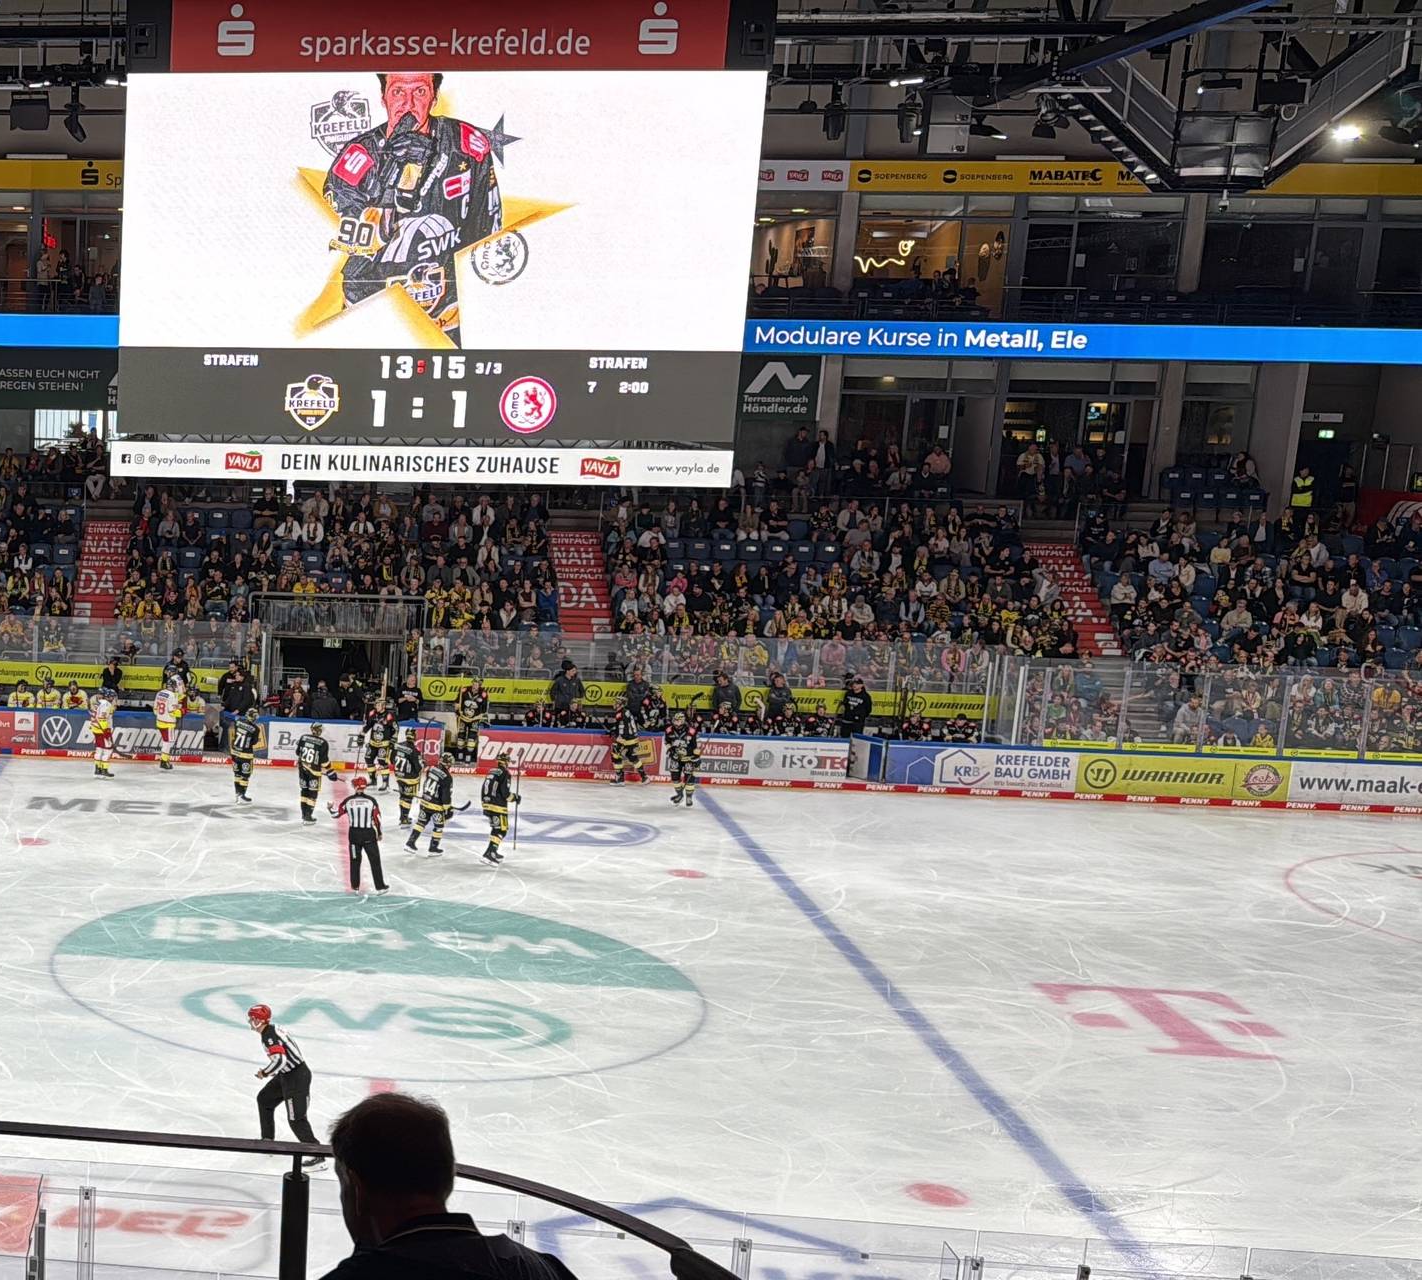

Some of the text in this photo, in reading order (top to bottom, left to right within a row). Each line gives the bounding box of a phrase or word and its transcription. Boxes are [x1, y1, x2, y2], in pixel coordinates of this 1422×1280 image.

[299, 27, 591, 58] sparkasse-krefeld.de
[314, 120, 369, 135] KREFELD
[874, 173, 928, 181] SOEPENBERG
[960, 173, 1014, 181] SOEPENBERG
[1029, 168, 1103, 182] MABATEC
[338, 219, 374, 247] 90
[417, 228, 462, 261] SWK
[754, 326, 1088, 352] Modulare Kurse in Metall, Ele
[203, 354, 259, 367] STRAFEN
[589, 357, 648, 370] STRAFEN
[380, 355, 503, 380] 13:15 3/3
[35, 369, 65, 379] EUCH
[67, 369, 101, 380] NICHT
[0, 381, 35, 391] REGEN
[38, 381, 84, 392] STEHEN!
[587, 381, 648, 394] 7 2:00
[289, 399, 336, 409] KREFELD
[510, 391, 520, 419] DEG
[743, 394, 809, 404] Terrassendach
[371, 390, 386, 427] 1
[452, 390, 468, 428] 1
[742, 403, 808, 415] Händler.de
[148, 454, 211, 467] @yaylaonline
[228, 453, 261, 471] YAYLA
[281, 453, 560, 474] DEIN KULINARISCHES ZUHAUSE
[582, 459, 619, 476] YAYLA
[646, 463, 720, 476] www.yayla.de
[88, 523, 131, 534] EINFACH
[551, 533, 597, 544] EINFACH
[83, 556, 126, 567] EINFACH
[555, 568, 603, 579] EINFACH
[78, 569, 121, 594] DA.
[558, 582, 607, 608] DA.
[235, 732, 246, 751] 71
[301, 748, 315, 763] 26
[996, 755, 1071, 768] KREFELDER
[523, 763, 598, 772] Vertrauen erfahren
[714, 761, 748, 773] Keller?
[954, 765, 981, 777] KRB
[994, 767, 1071, 780] BAU GMBH
[1121, 768, 1225, 786] WARRIOR
